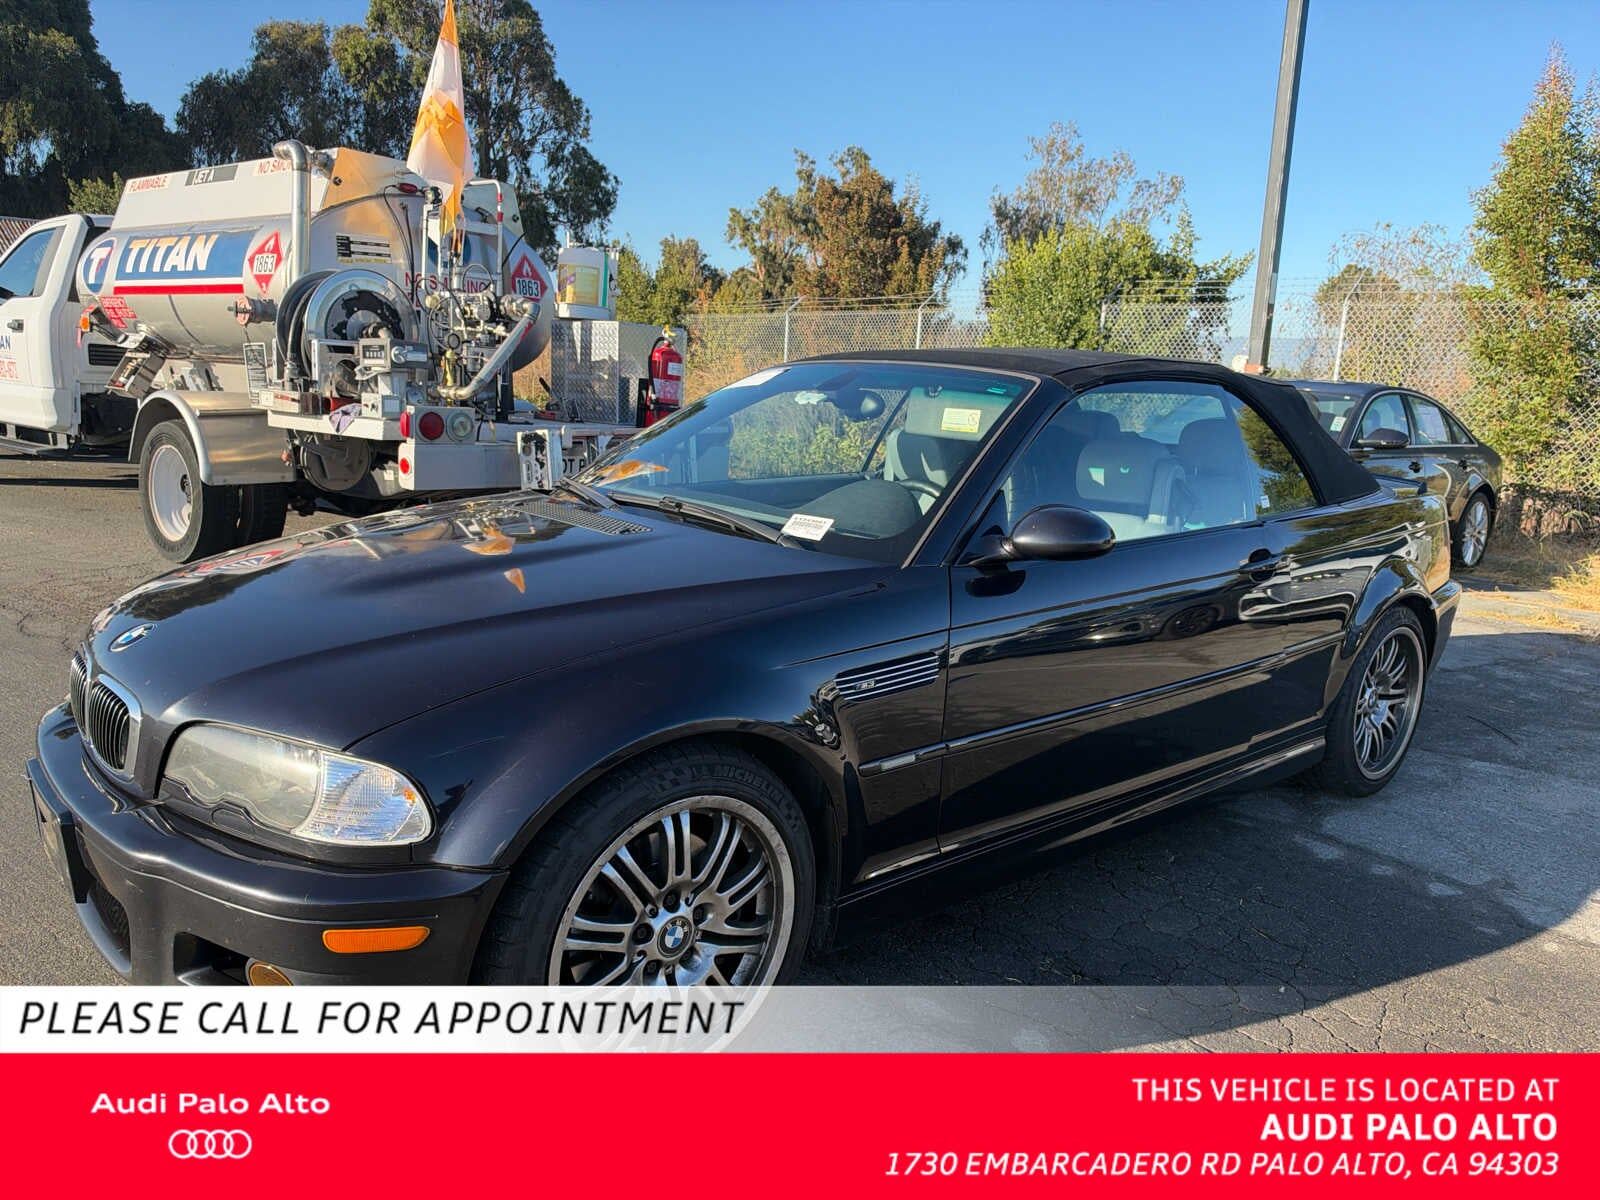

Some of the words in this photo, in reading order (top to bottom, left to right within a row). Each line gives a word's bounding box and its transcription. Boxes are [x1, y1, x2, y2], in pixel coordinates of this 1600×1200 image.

[125, 233, 219, 273] TITAN
[255, 255, 276, 273] 1863
[517, 279, 539, 297] 1863
